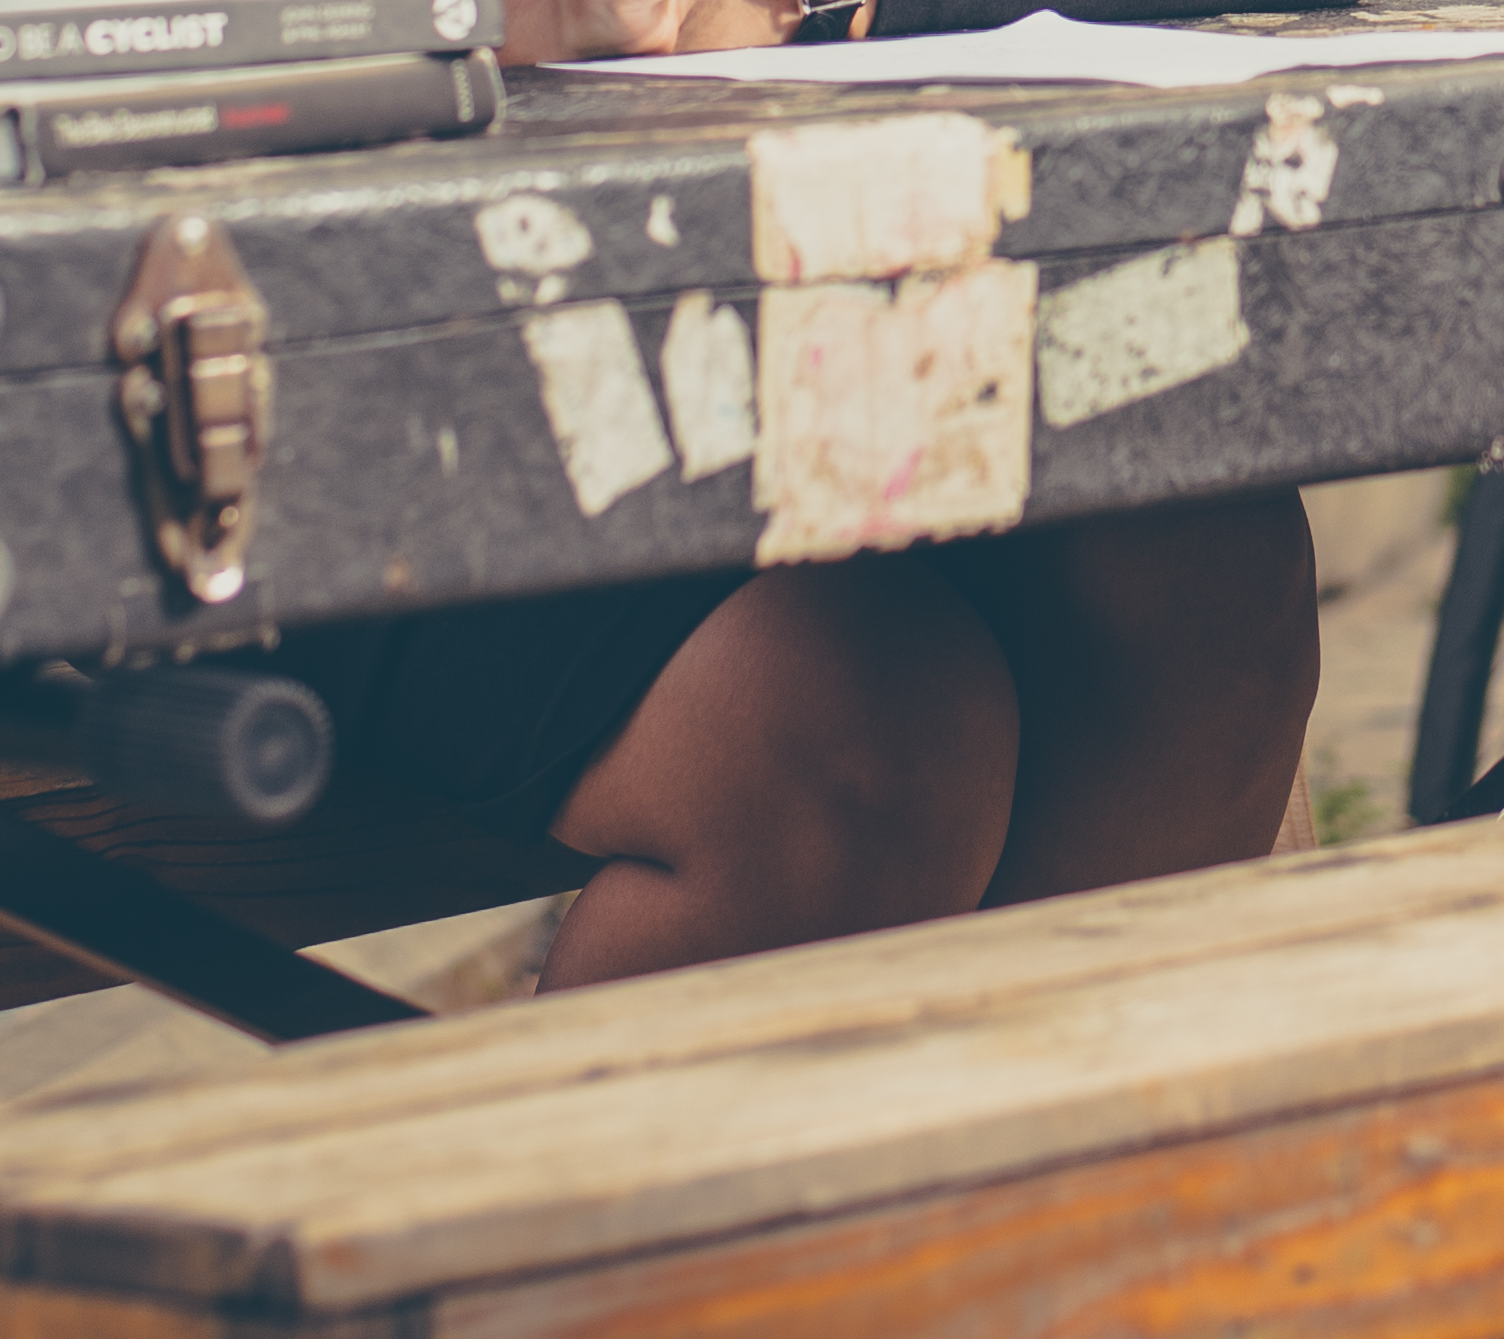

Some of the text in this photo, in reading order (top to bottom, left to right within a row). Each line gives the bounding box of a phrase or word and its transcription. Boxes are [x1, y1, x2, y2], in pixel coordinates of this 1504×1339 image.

[17, 22, 57, 61] BE
[55, 21, 86, 58] A
[84, 12, 229, 55] CYCLIST
